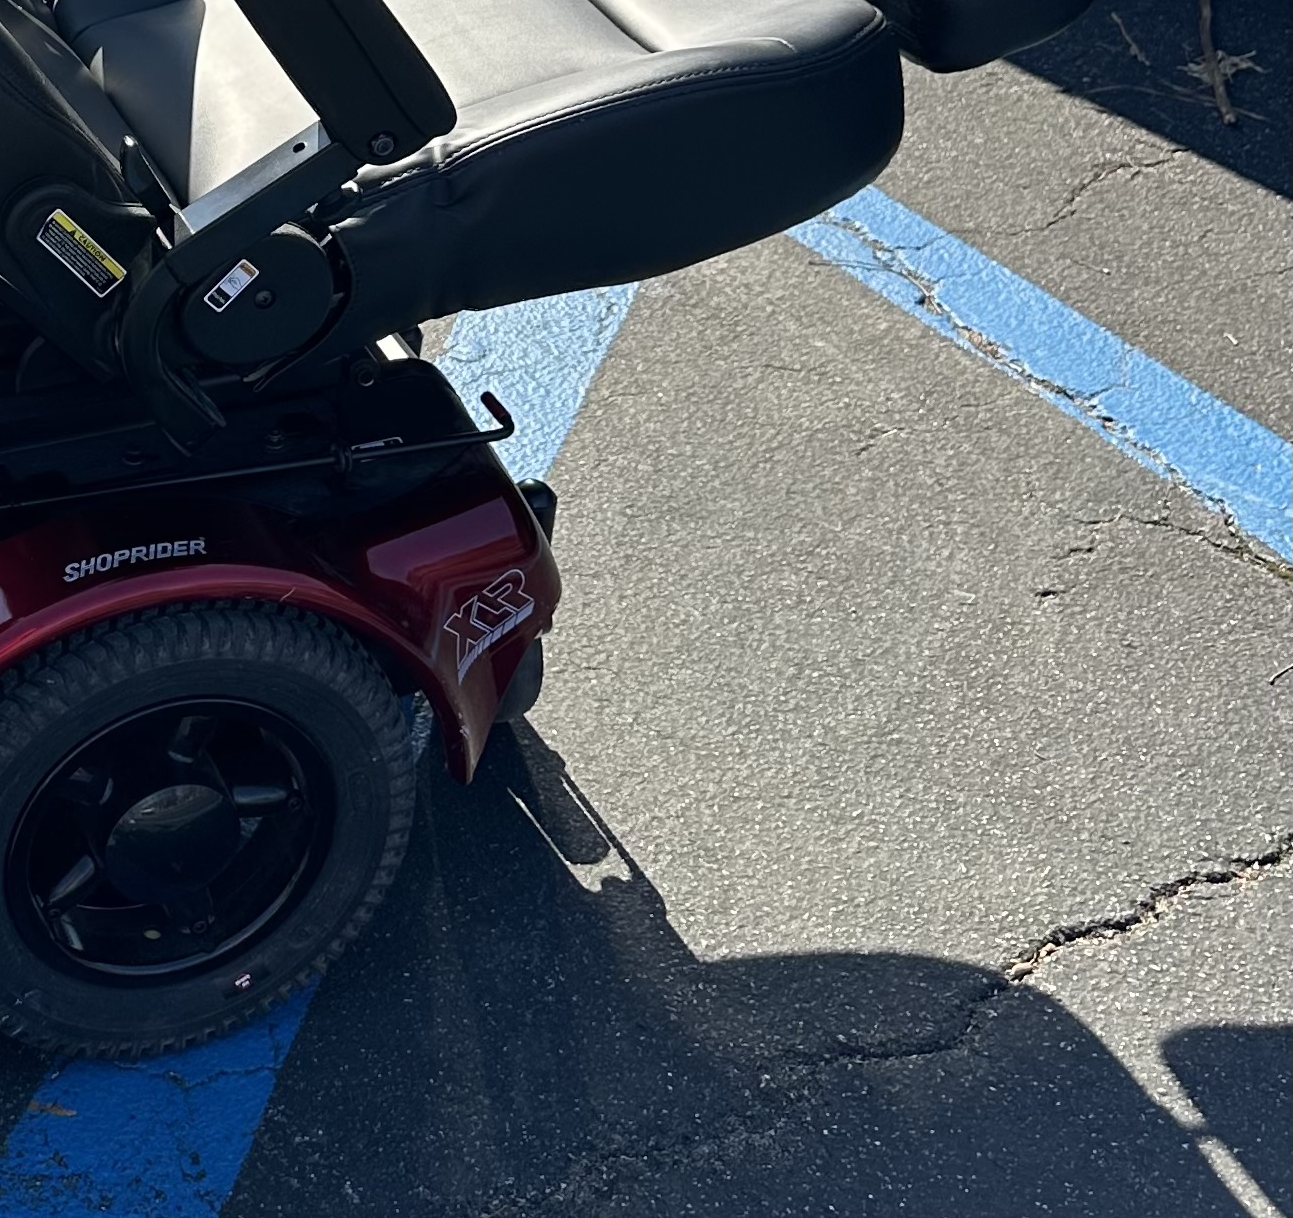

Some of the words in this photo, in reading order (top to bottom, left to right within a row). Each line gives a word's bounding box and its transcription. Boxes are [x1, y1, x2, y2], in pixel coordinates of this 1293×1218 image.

[78, 234, 107, 262] CAUTION
[62, 539, 207, 582] SHOPRIDER
[443, 569, 535, 685] XLR
